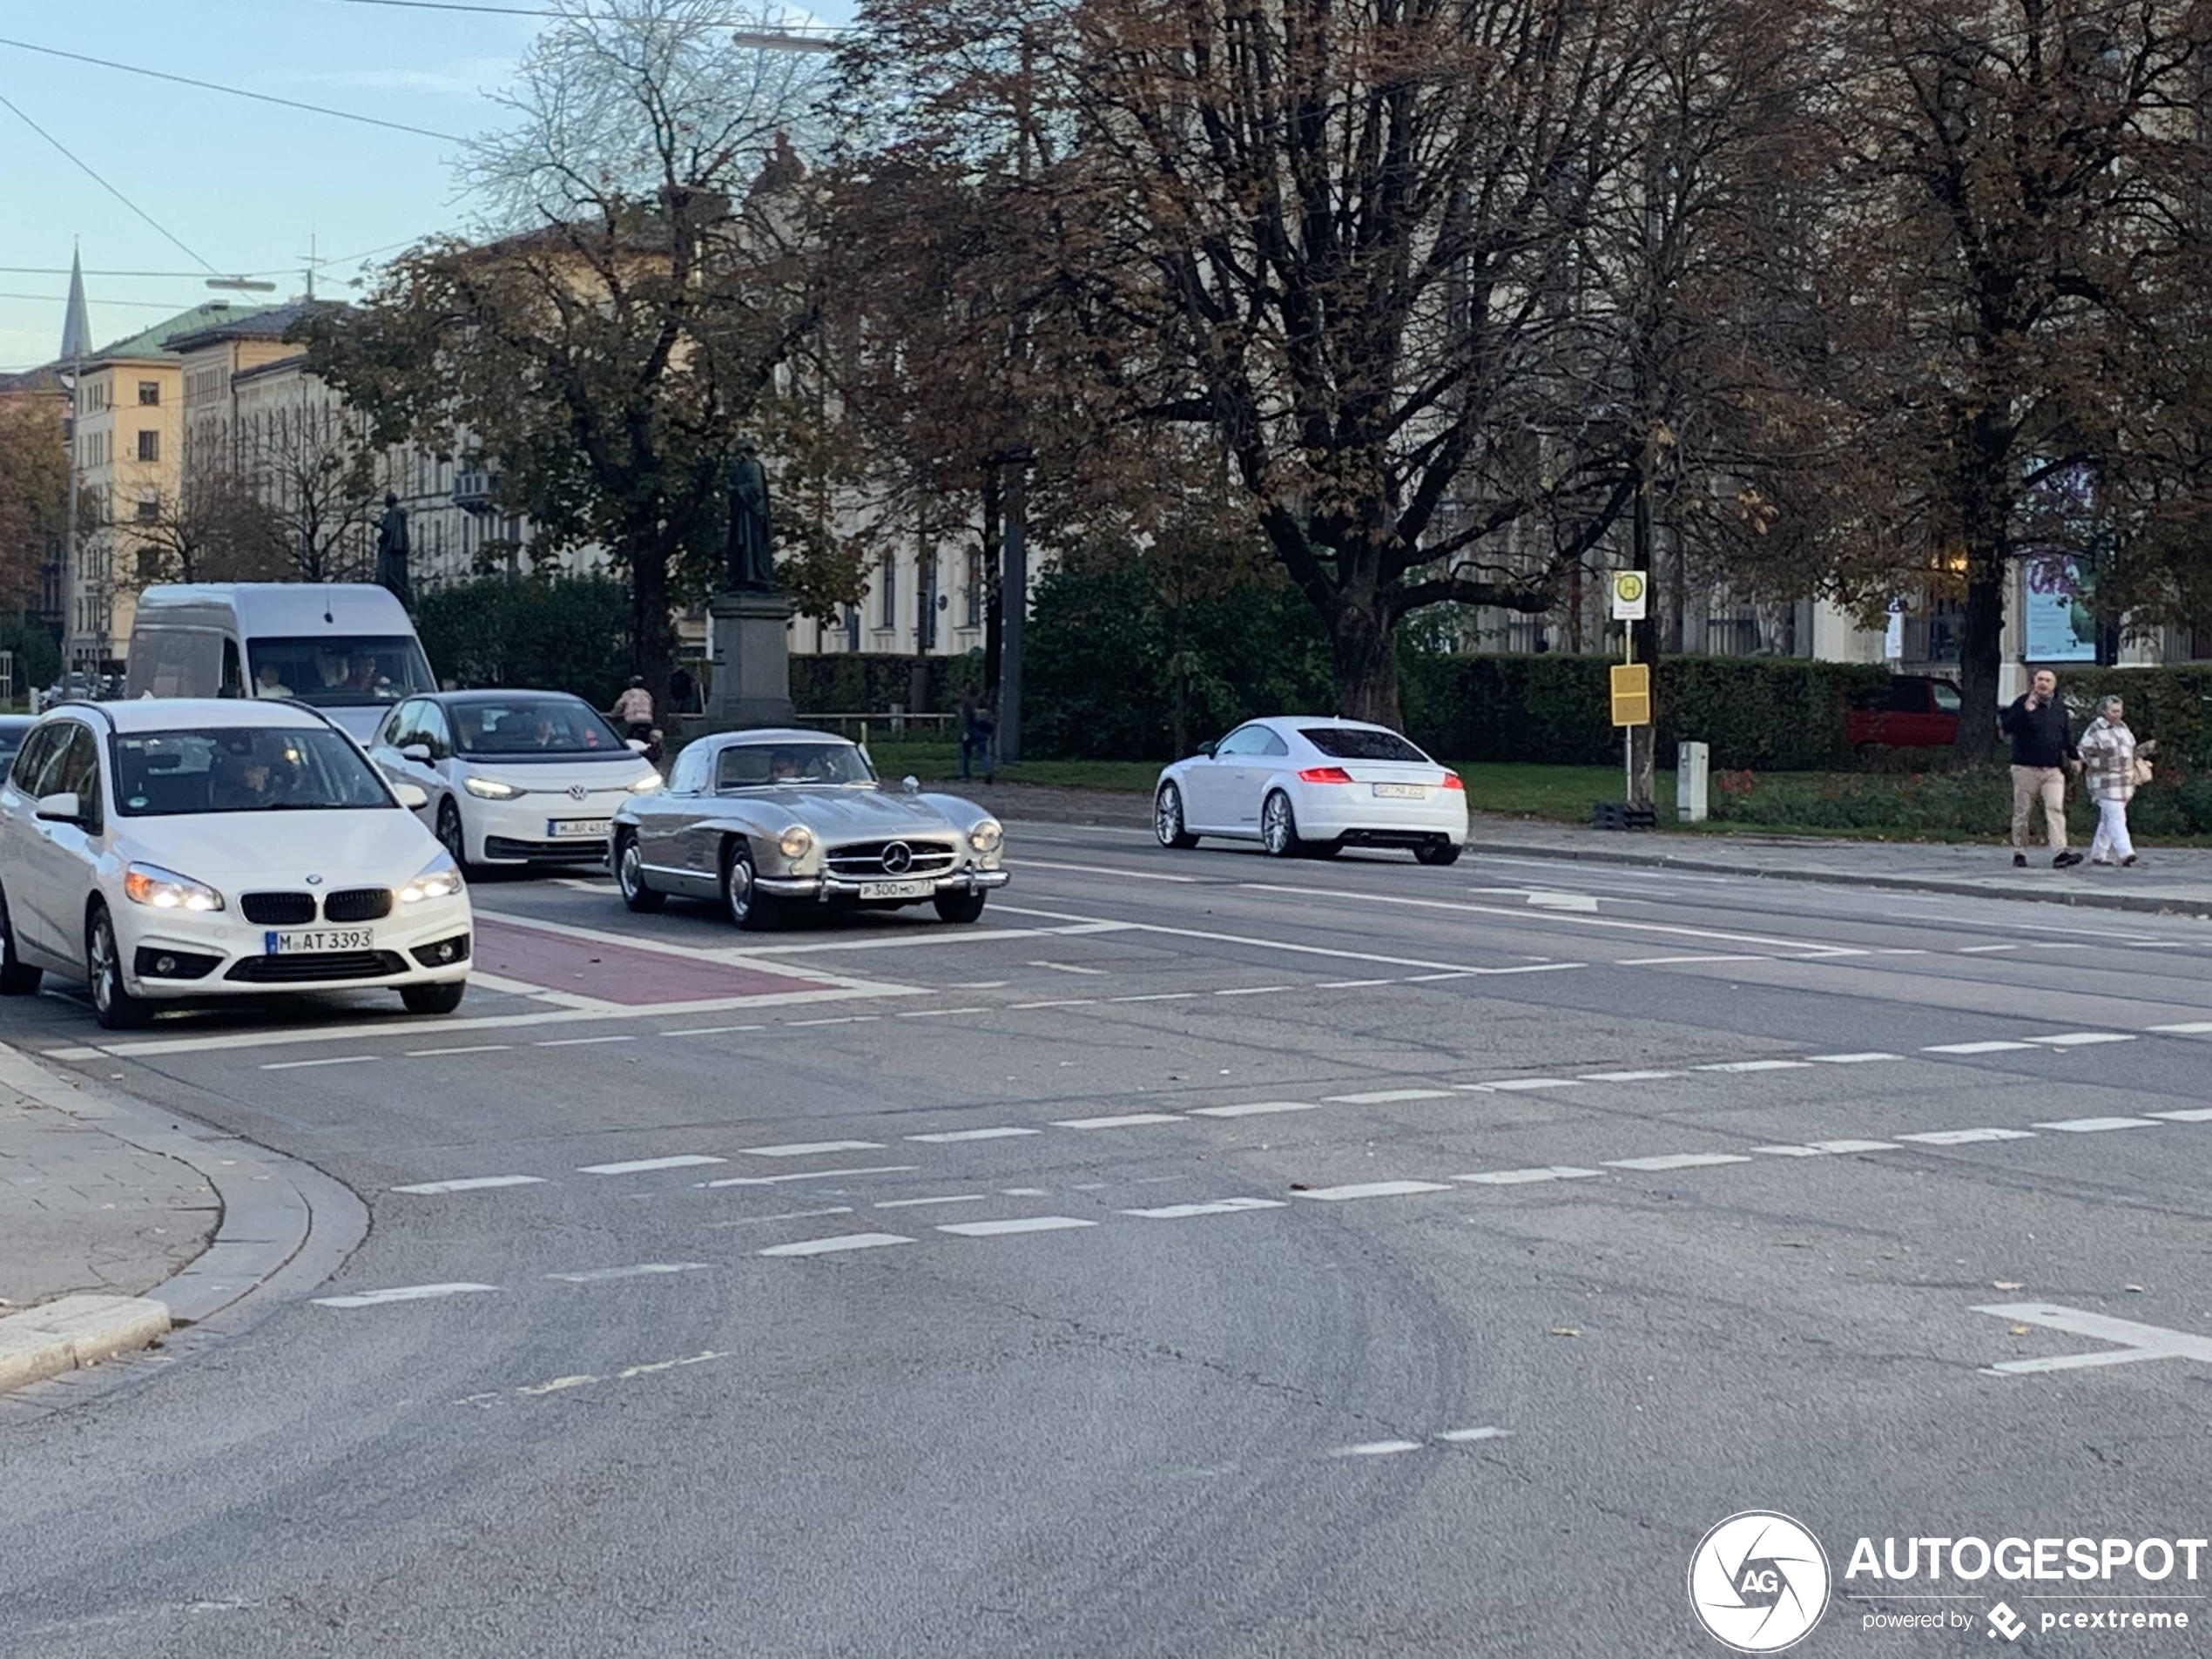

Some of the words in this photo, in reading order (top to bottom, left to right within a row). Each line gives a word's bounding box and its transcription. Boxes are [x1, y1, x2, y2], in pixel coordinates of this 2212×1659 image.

[873, 882, 898, 896] 300
[280, 934, 292, 951] M
[303, 933, 325, 950] AT
[328, 931, 371, 949] 3393
